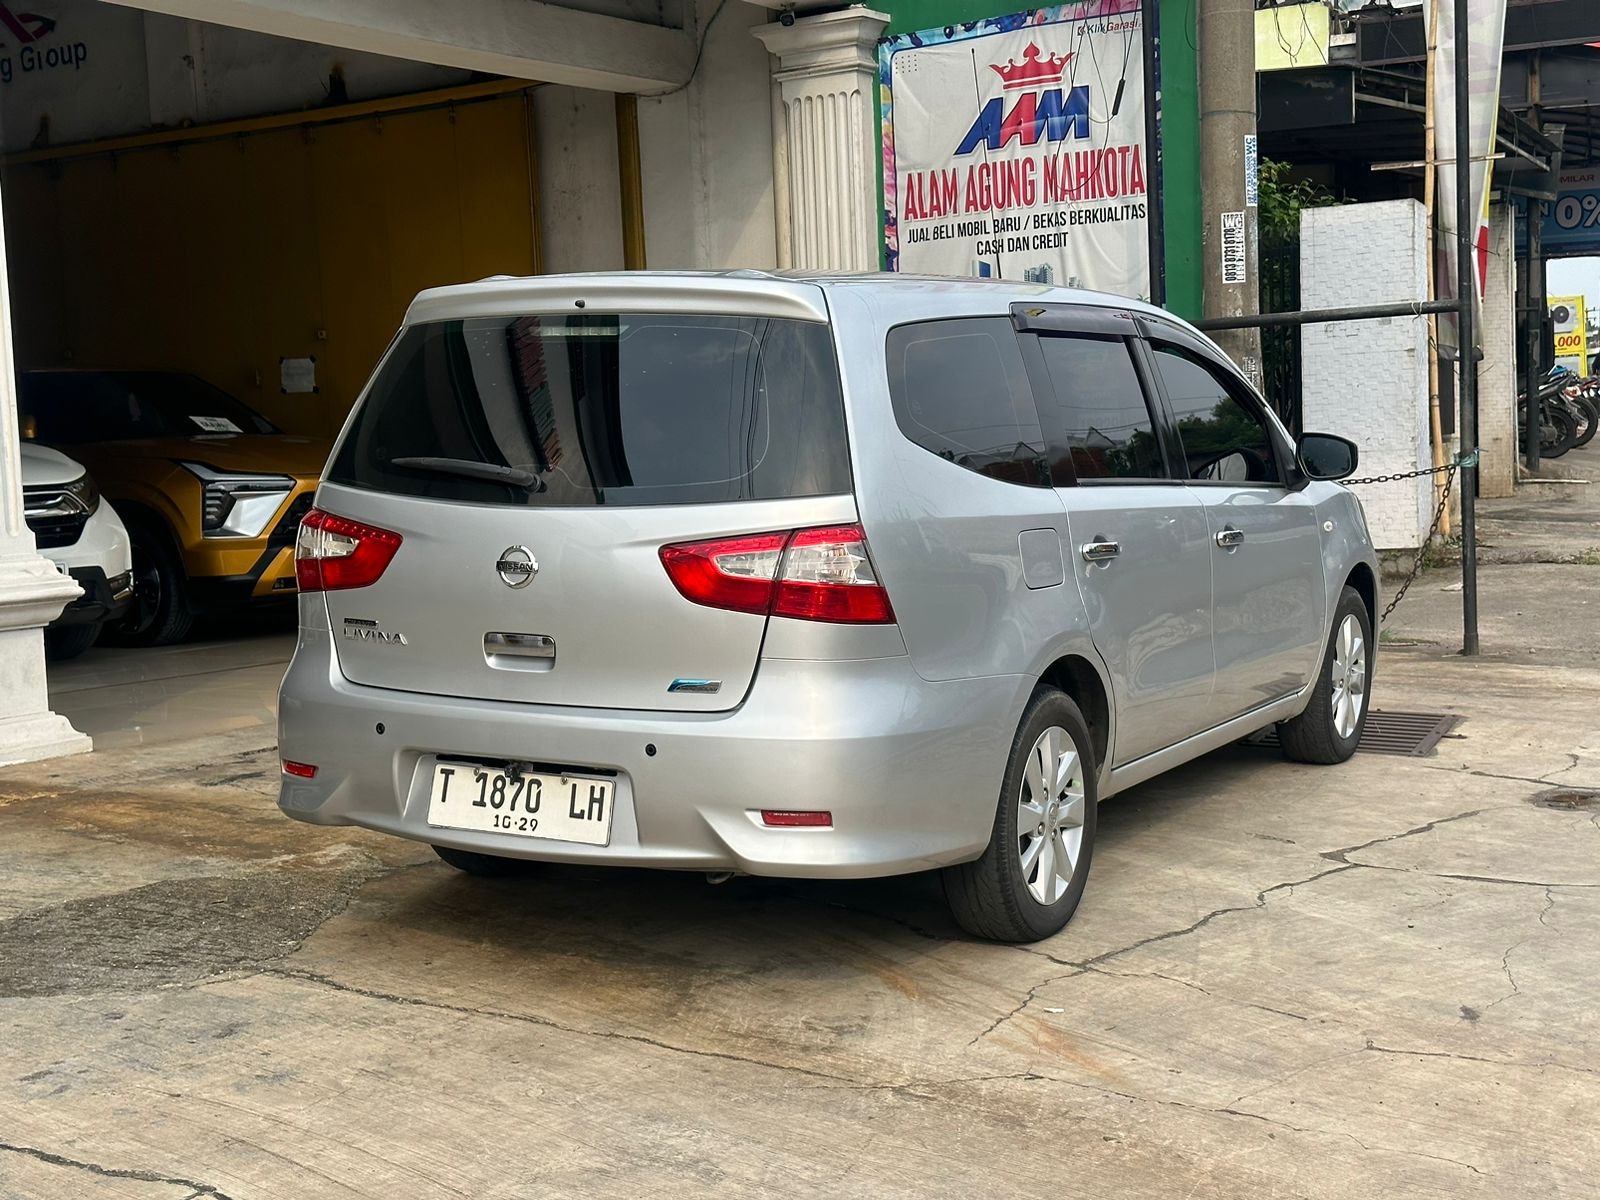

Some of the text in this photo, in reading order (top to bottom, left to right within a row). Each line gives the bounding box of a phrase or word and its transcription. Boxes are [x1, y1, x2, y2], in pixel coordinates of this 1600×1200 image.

[953, 85, 1090, 156] AAM
[904, 144, 1146, 220] ALAM AGUNG MAHKOTA
[907, 203, 1146, 244] JUAL BELI MOBIL BARU / BEKAS BERKUALITAS
[1223, 216, 1243, 228] WC
[976, 232, 1068, 256] CASH DAN CREDIT
[1223, 245, 1236, 262] 8731
[1224, 264, 1237, 281] 0813
[497, 561, 534, 573] NISSAN
[343, 627, 408, 646] LIVINA
[440, 768, 606, 822] T 1870 LH
